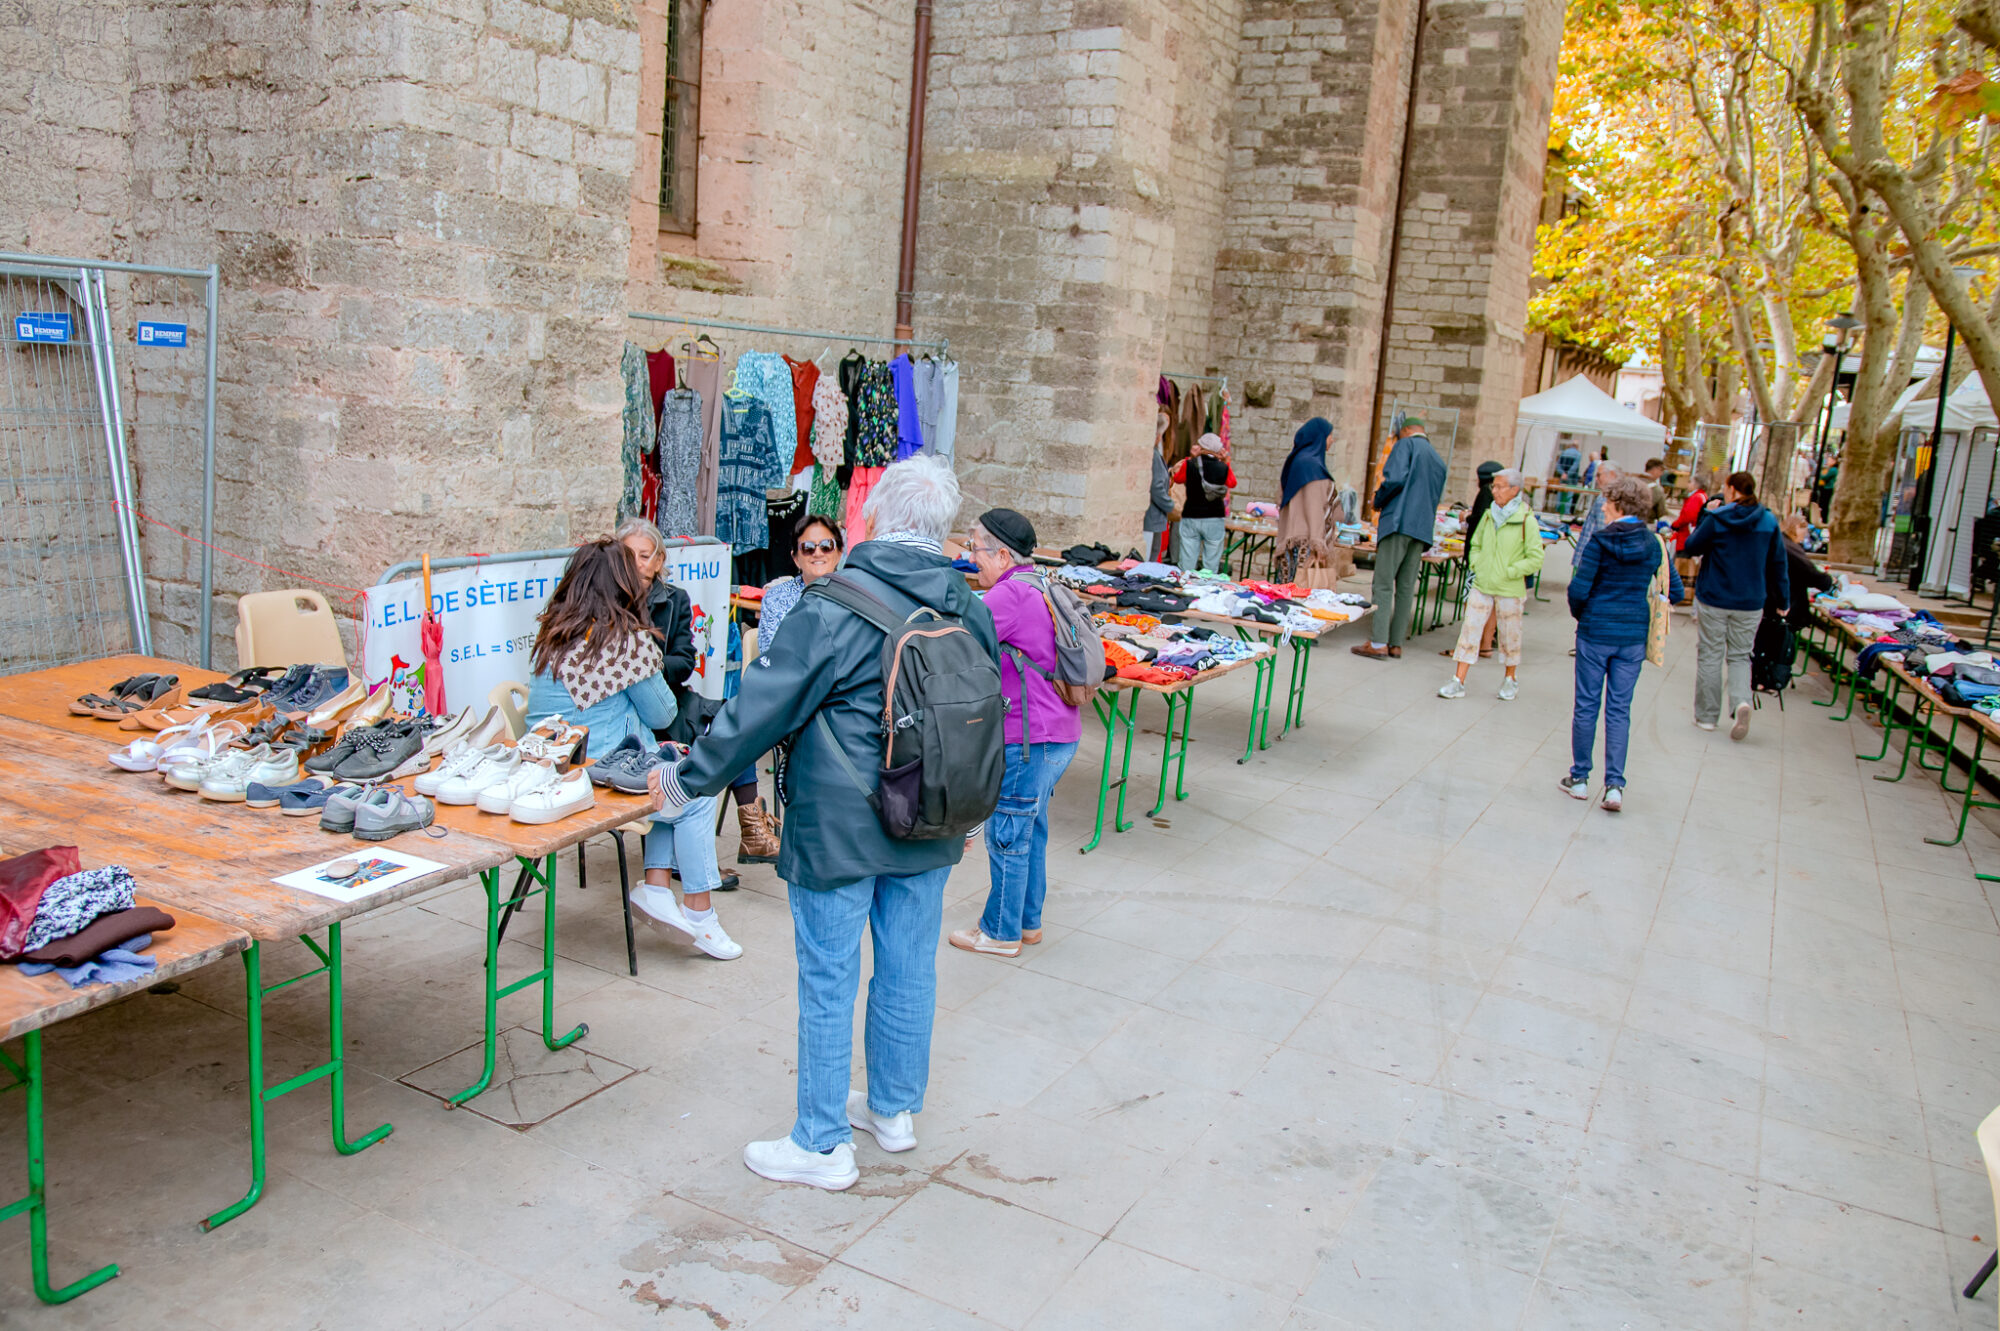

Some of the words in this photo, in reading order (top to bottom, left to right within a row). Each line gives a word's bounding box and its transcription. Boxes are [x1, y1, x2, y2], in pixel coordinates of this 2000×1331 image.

[372, 600, 421, 628] .E.L.
[431, 590, 459, 615] DE
[465, 579, 518, 607] SÈTE
[524, 578, 548, 599] ET
[678, 561, 720, 581] THAU
[450, 643, 486, 663] S.E.L
[506, 632, 535, 654] SYSTÈ
